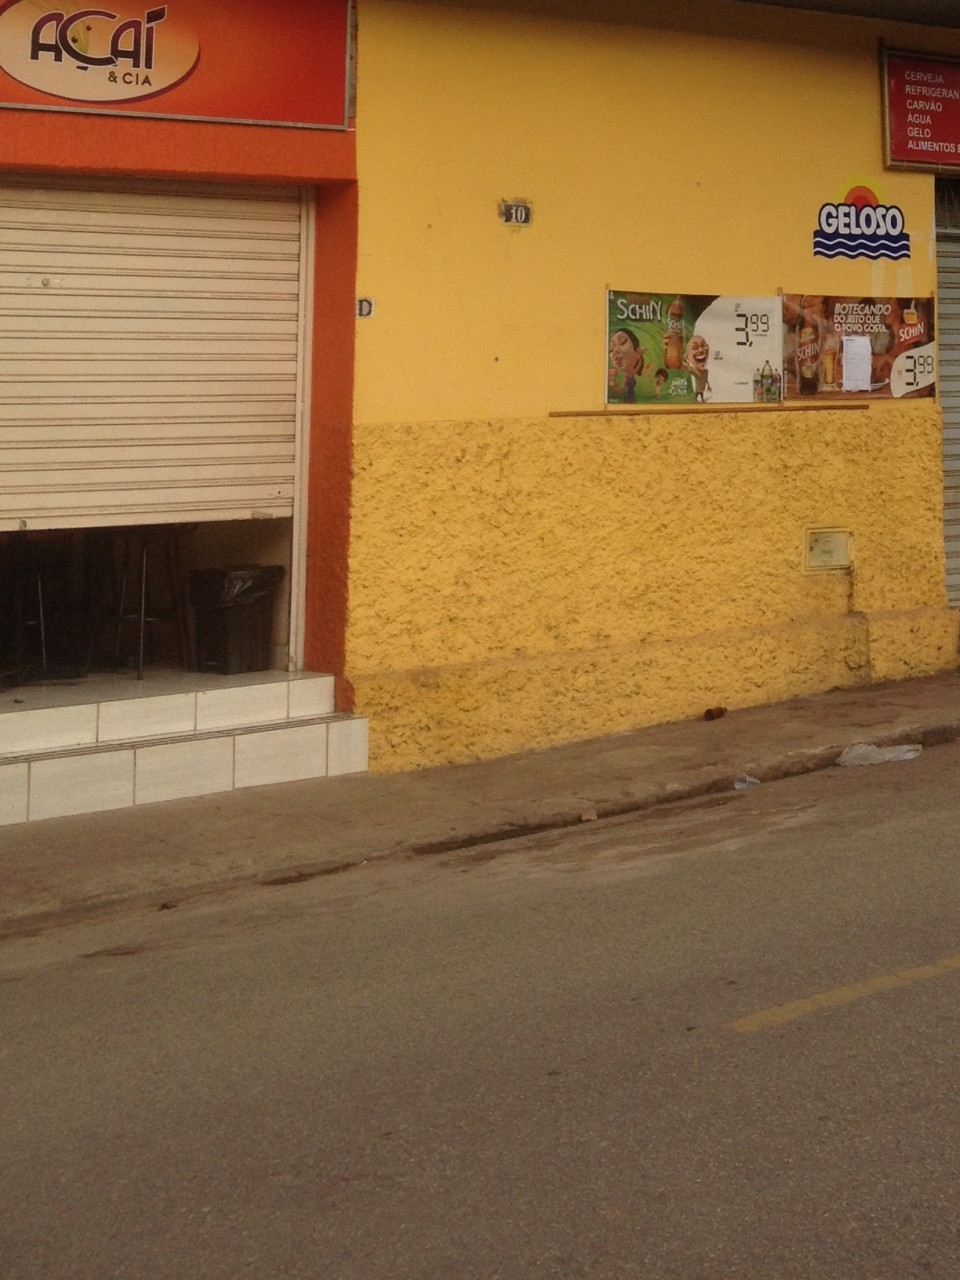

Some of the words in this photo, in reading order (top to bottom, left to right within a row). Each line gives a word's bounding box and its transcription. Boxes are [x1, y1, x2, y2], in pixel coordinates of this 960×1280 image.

[108, 71, 118, 84] &
[122, 73, 152, 86] CIA
[905, 70, 944, 84] CERVEJA
[907, 99, 943, 112] CARVÃO
[907, 127, 931, 139] GELO
[907, 140, 956, 153] ALIMENTOS
[511, 206, 526, 222] 10
[819, 204, 903, 236] GELOSO
[358, 299, 373, 317] D
[834, 302, 892, 315] BOTECANDO
[834, 314, 846, 323] DO
[846, 314, 865, 324] JEITO
[865, 315, 881, 324] QUE
[834, 323, 841, 332] O
[842, 323, 863, 332] POVO
[899, 322, 924, 342] SCHIN
[797, 340, 820, 361] SCHIN
